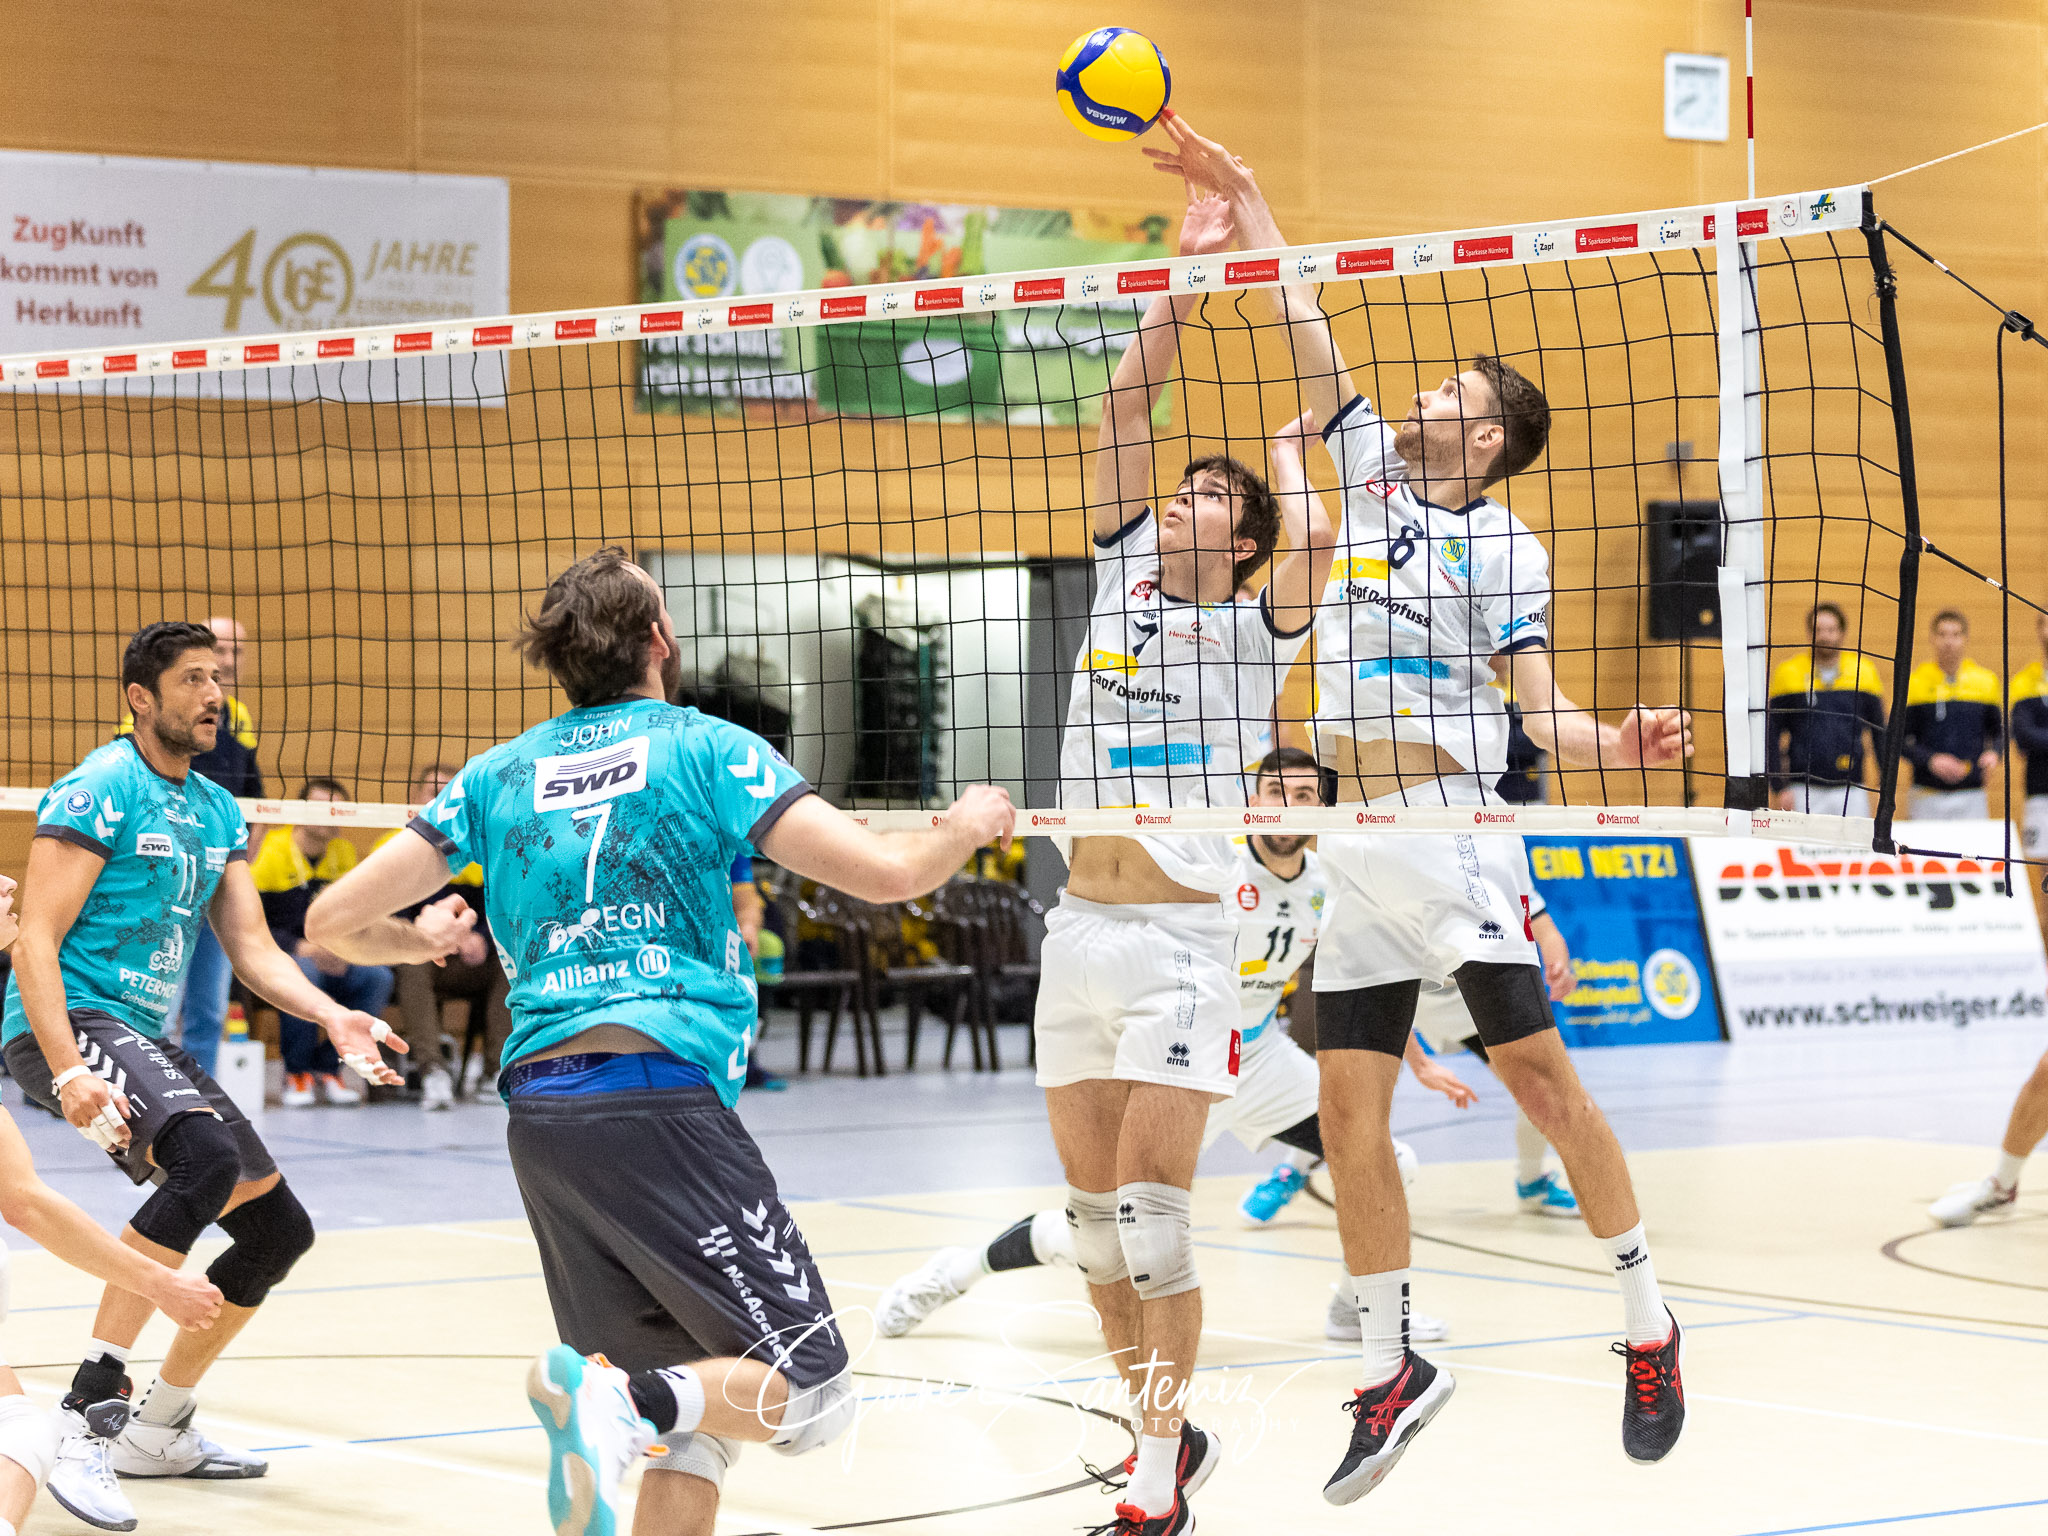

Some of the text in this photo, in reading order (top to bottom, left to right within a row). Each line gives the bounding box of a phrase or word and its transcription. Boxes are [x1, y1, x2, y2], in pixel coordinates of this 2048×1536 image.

[1810, 203, 1837, 216] HUCK
[13, 215, 146, 252] ZugKunft
[1666, 229, 1681, 239] Zapf
[1588, 235, 1634, 246] Sparkasse Nürnberg
[1466, 246, 1509, 257] Sparkasse Nürnberg
[1540, 242, 1554, 252] Zapf
[364, 239, 479, 281] JAHRE
[1348, 258, 1390, 269] Sparkasse Nürnberg
[1419, 253, 1433, 263] Zapf
[0, 254, 158, 289] kommt von
[1235, 269, 1275, 279] Sparkasse Nürnberg
[1303, 264, 1317, 274] Zapf
[1128, 278, 1166, 289] Sparkasse Nürnberg
[1193, 275, 1206, 284] Zapf
[1024, 289, 1042, 297] Sparkasse
[1087, 284, 1099, 294] Zapf
[984, 293, 997, 302] Zapf
[887, 301, 898, 310] Zapf
[15, 298, 143, 329] Herkunft
[793, 309, 804, 318] Zapf
[1168, 629, 1221, 647] Heinzemann
[560, 715, 633, 747] JOHN
[542, 760, 638, 800] SWD
[1039, 815, 1066, 825] Marmot
[1143, 814, 1172, 824] Marmot
[1251, 813, 1281, 824] Marmot
[1364, 813, 1396, 824] Marmot
[1483, 812, 1515, 823] Marmot
[1606, 813, 1640, 825] Marmot
[142, 843, 171, 853] SWD
[571, 803, 612, 903] 7
[1530, 846, 1584, 880] EIN
[1588, 844, 1679, 879] NETZ!
[179, 851, 197, 905] 11
[602, 902, 666, 933] EGN
[1264, 926, 1296, 962] 11
[541, 959, 631, 996] Allianz
[1739, 989, 2044, 1028] www.schweiger.de
